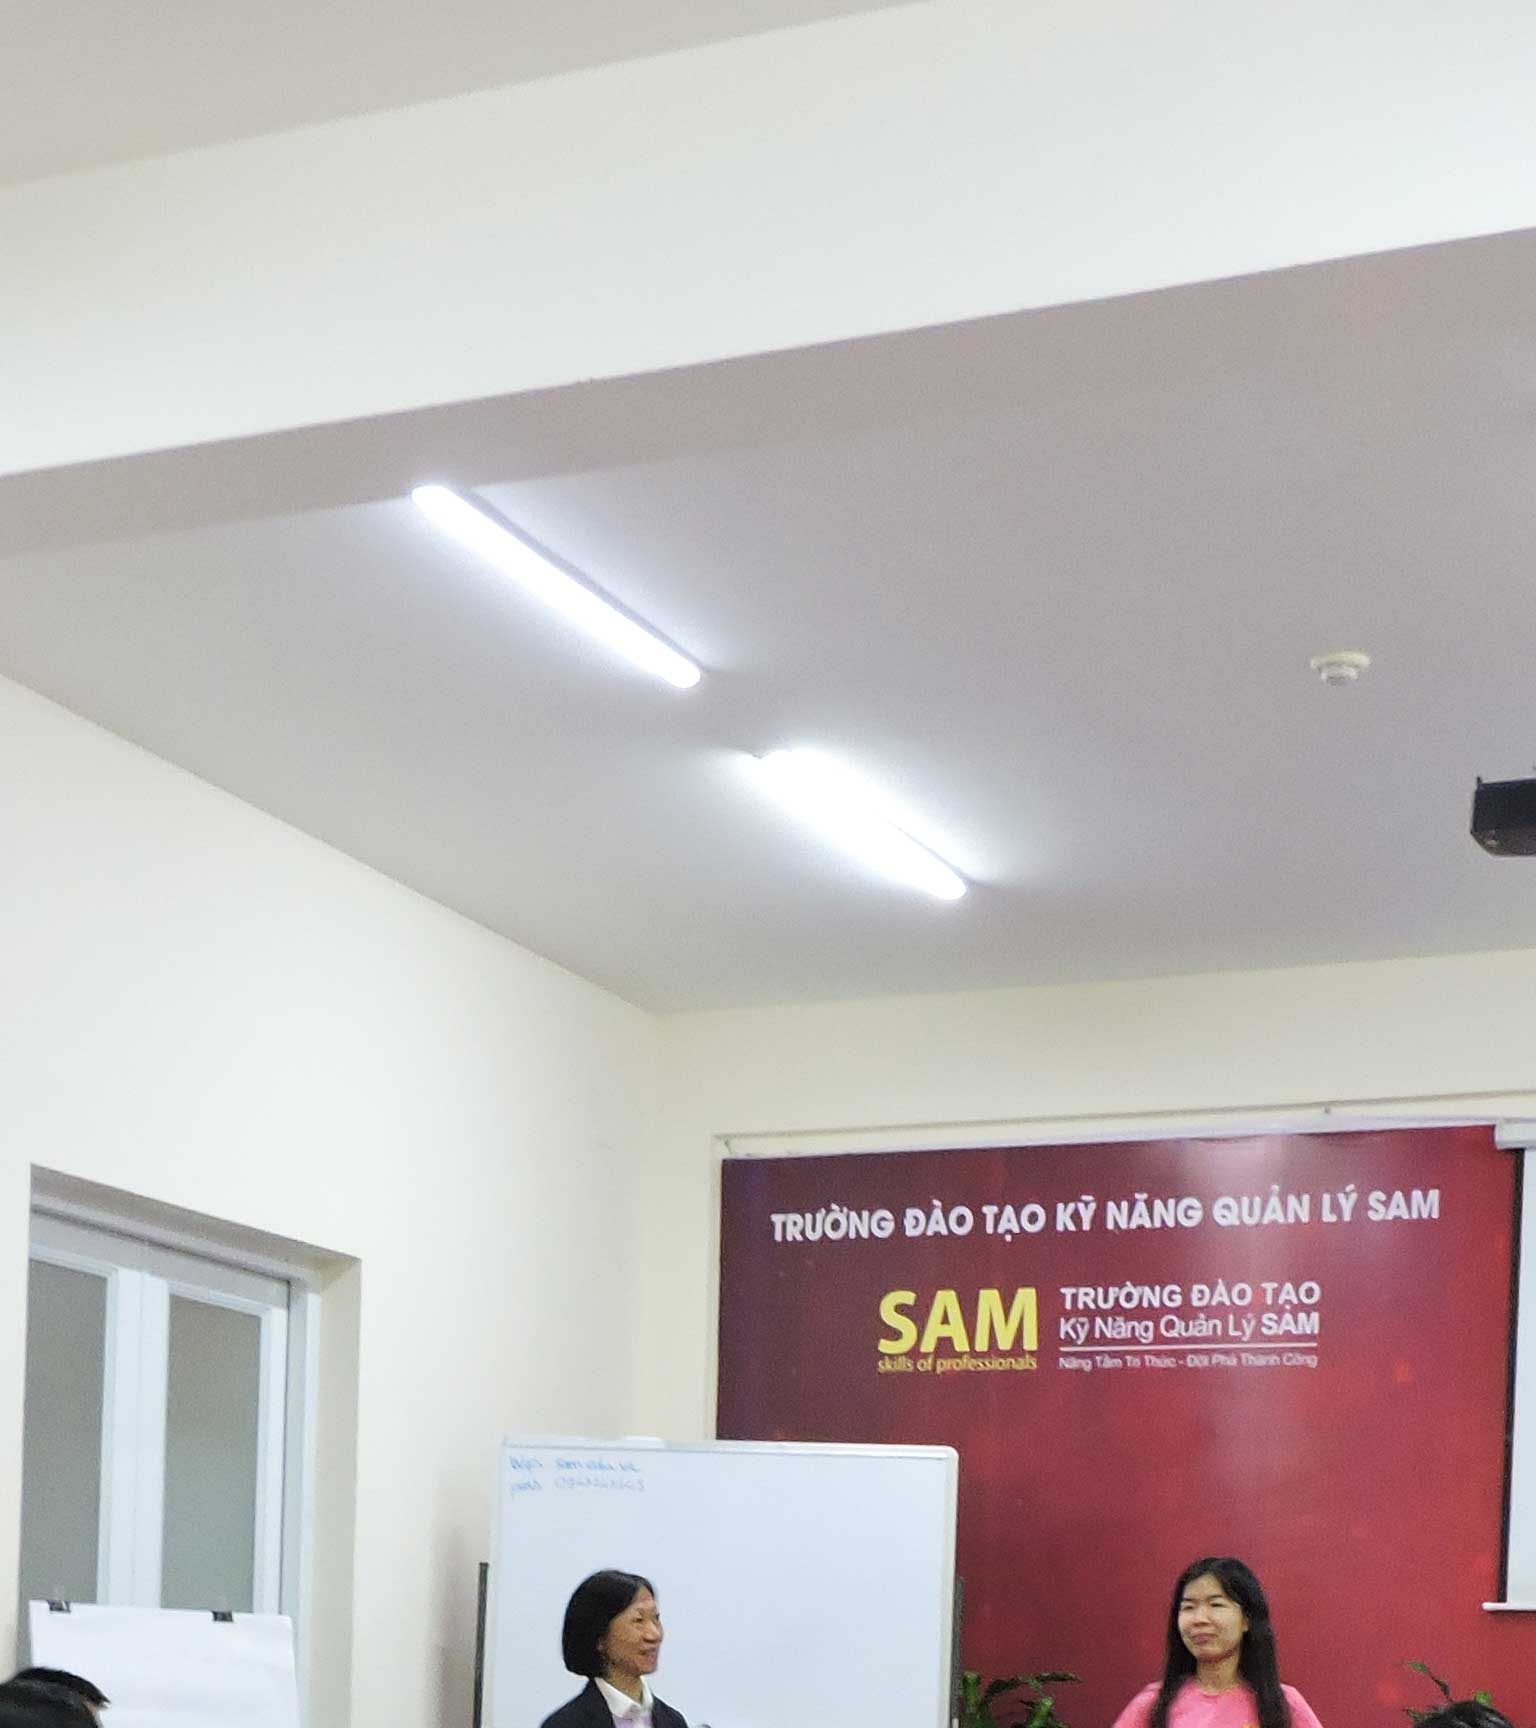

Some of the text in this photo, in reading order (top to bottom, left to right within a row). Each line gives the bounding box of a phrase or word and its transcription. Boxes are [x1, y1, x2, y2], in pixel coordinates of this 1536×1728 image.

[770, 1184, 1440, 1242] TRƯỜNG ĐÀO TẠO KỸ NĂNG QUẢN LÝ SAM
[1059, 1278, 1321, 1310] TRƯỜNG ĐÀO TẠO
[878, 1287, 1038, 1354] SAM
[1260, 1311, 1320, 1335] SAM
[878, 1353, 1037, 1374] skills of professionals
